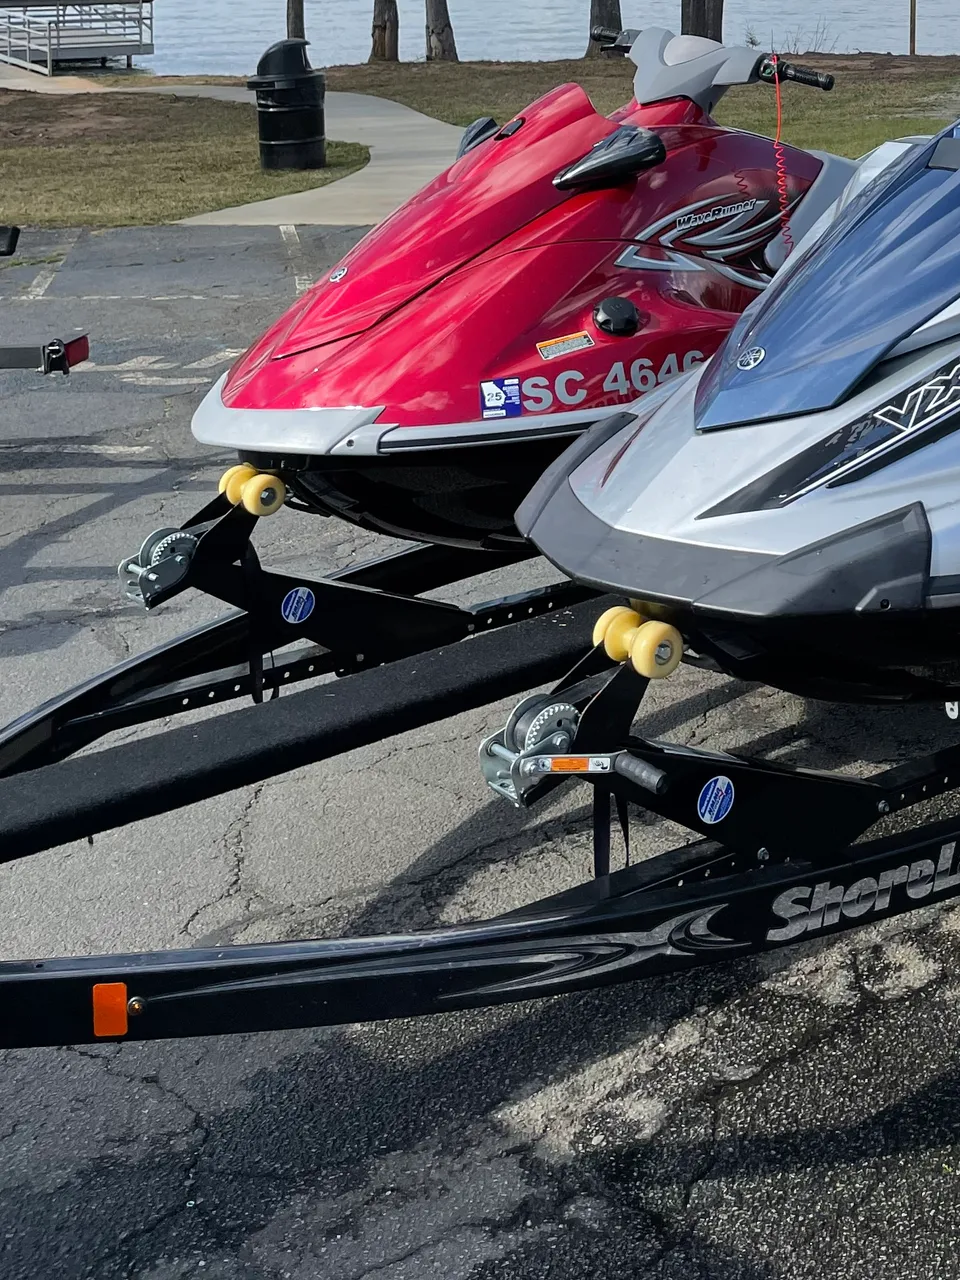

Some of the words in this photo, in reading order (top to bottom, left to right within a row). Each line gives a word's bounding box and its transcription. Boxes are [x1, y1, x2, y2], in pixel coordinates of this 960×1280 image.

[676, 198, 757, 231] WaveRunner
[486, 391, 502, 402] 25
[521, 370, 588, 412] SC
